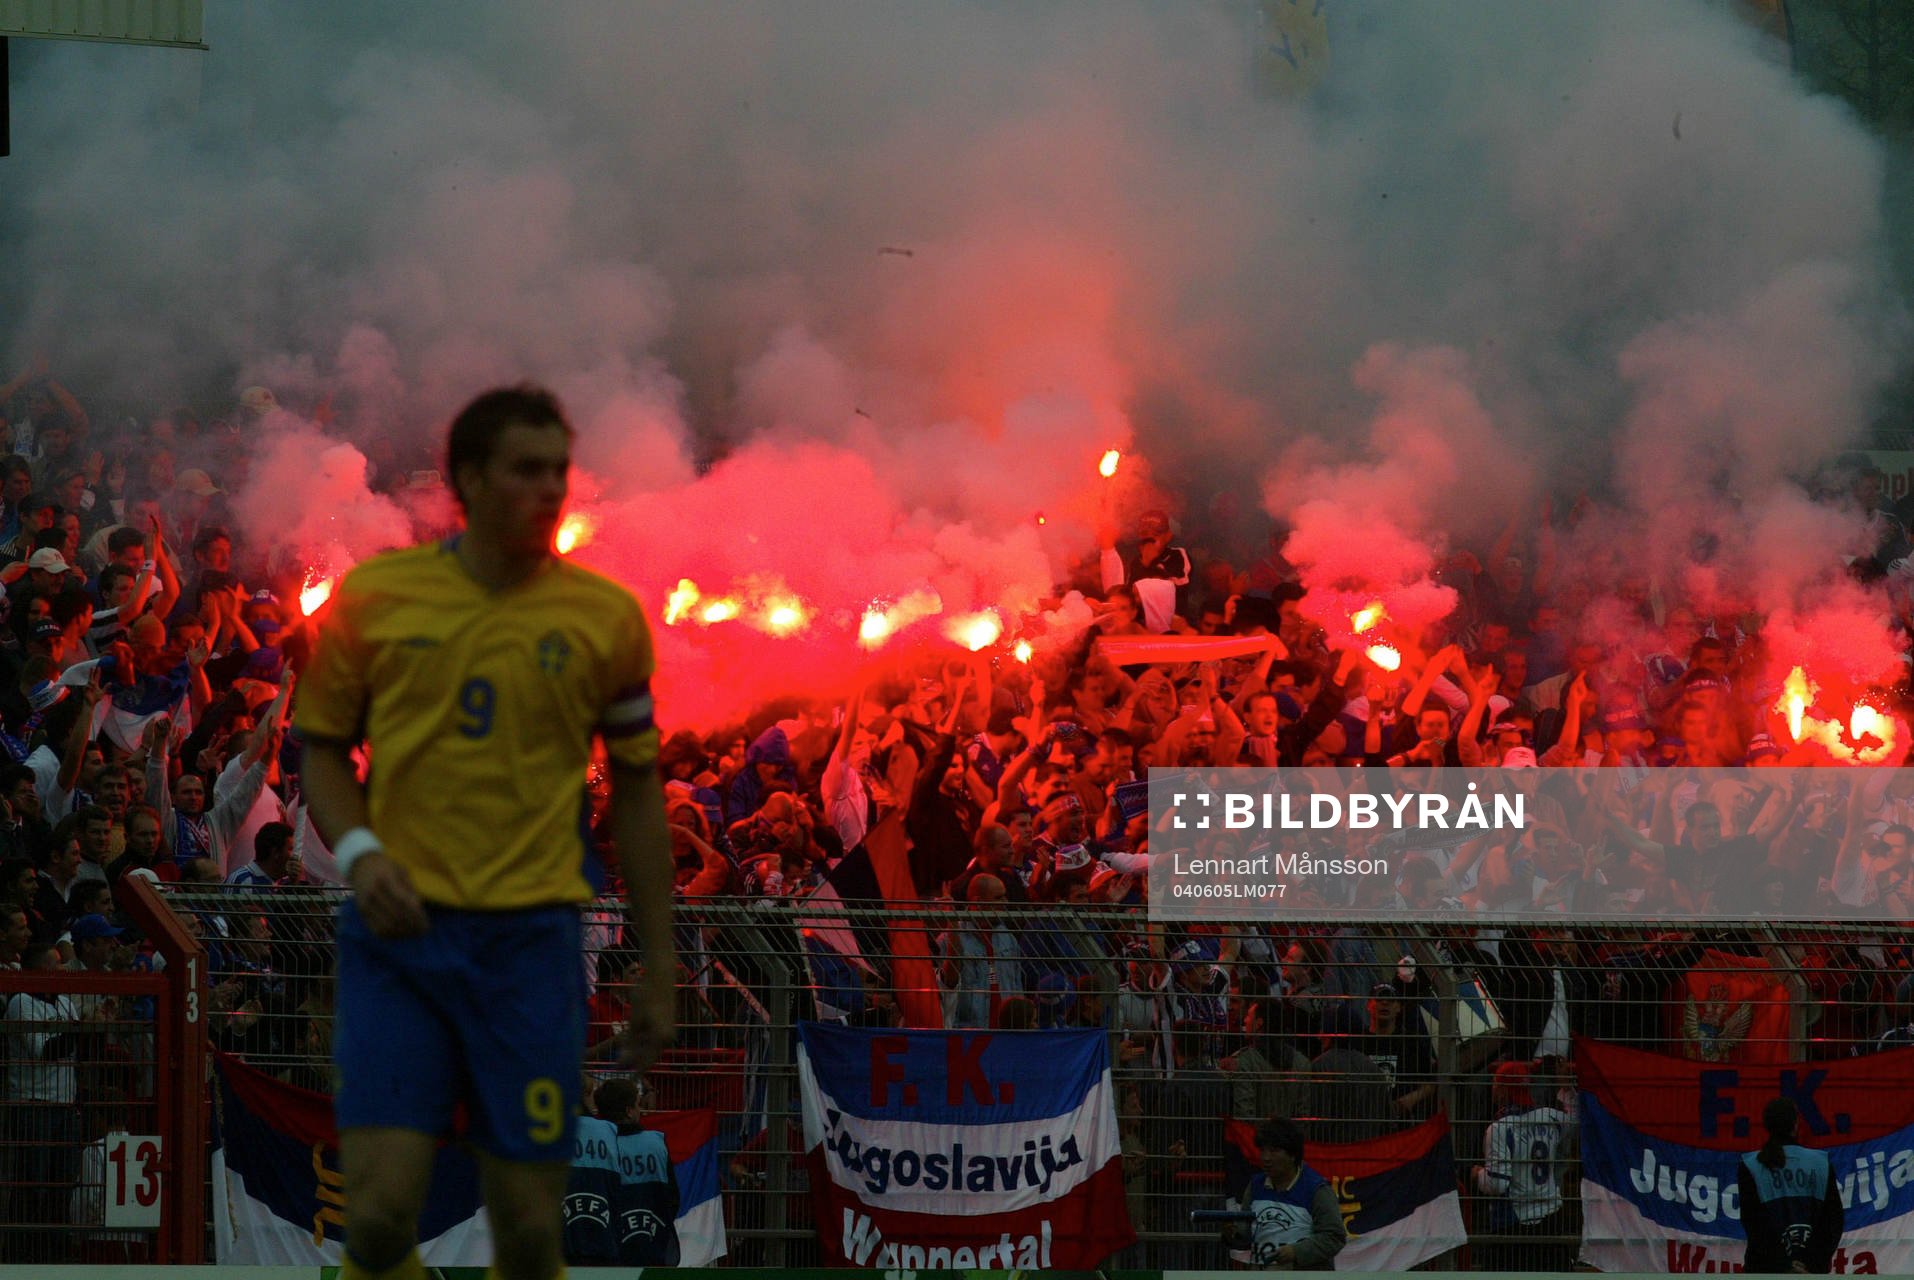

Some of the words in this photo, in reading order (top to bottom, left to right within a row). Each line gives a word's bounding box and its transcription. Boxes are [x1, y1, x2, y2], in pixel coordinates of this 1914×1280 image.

[459, 677, 497, 740] 9
[870, 1035, 918, 1107] F.
[946, 1034, 1015, 1106] K.
[1700, 1069, 1750, 1137] F.
[524, 1076, 565, 1145] 9
[109, 1142, 161, 1207] 13
[622, 1154, 657, 1177] 050
[823, 1108, 1083, 1194] Jugoslavija
